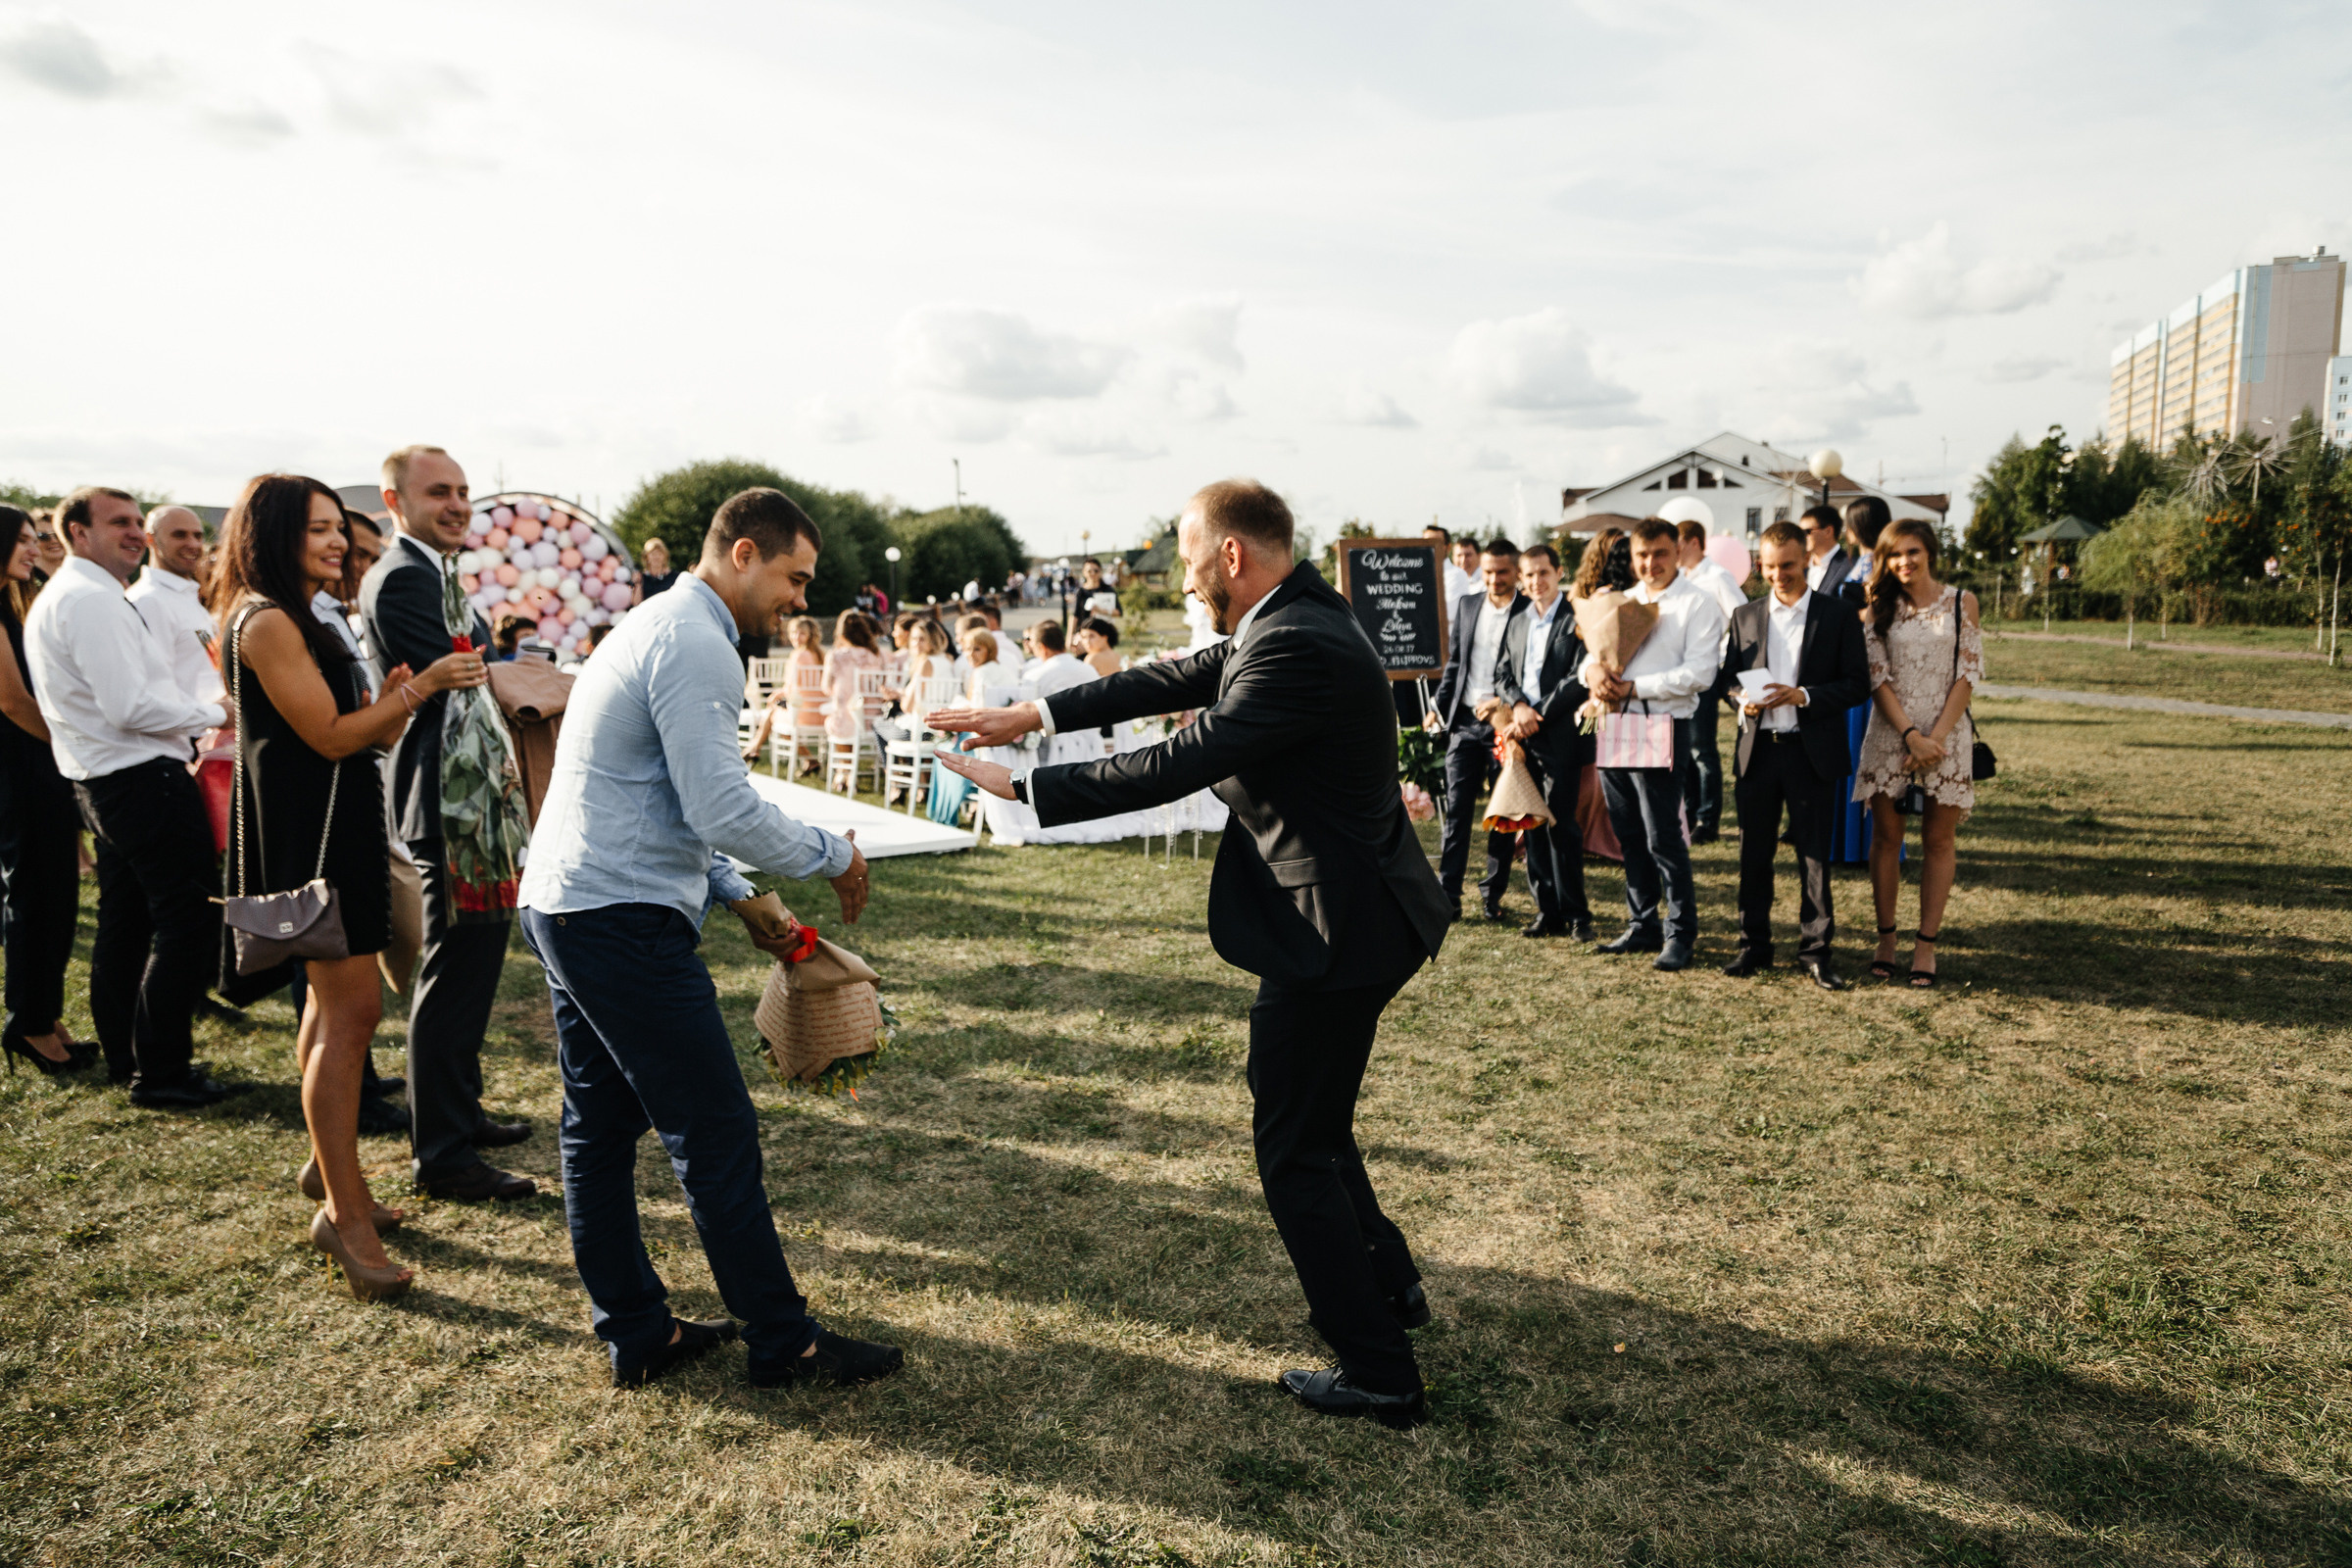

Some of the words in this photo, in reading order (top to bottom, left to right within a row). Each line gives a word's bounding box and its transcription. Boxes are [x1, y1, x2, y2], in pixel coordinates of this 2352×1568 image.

[1361, 549, 1424, 569] Welcome
[1380, 569, 1390, 581] to
[1366, 582, 1423, 595] WEDDING
